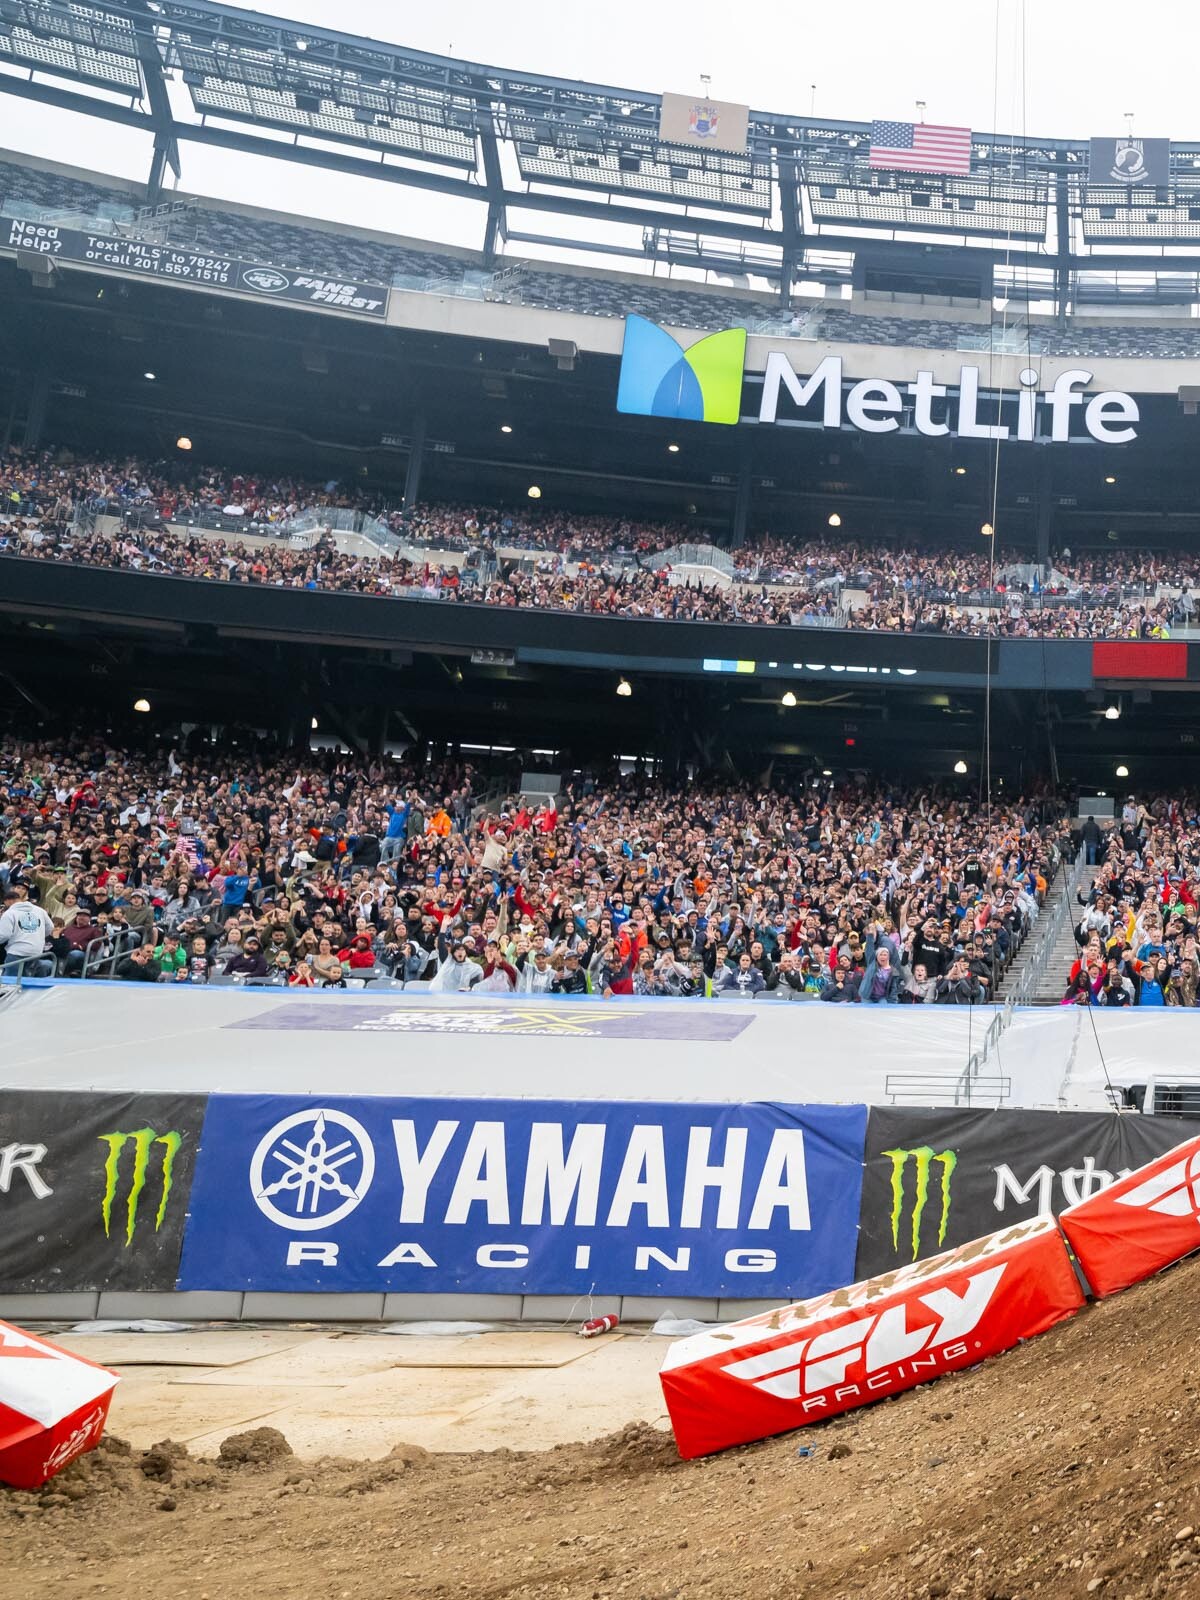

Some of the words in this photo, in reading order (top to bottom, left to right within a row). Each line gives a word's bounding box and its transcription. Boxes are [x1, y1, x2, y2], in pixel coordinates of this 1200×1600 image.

[8, 232, 62, 252] Help?
[11, 219, 59, 239] Need
[85, 249, 101, 259] or
[104, 252, 130, 266] call
[134, 257, 228, 283] 201.559.1515
[87, 237, 120, 251] Text
[171, 252, 185, 263] to
[189, 255, 231, 272] 78247
[293, 276, 357, 296] FANS
[311, 289, 383, 312] FIRST
[758, 351, 1140, 444] MetLife
[392, 1119, 811, 1230] YAMAHA
[286, 1241, 777, 1272] RACING
[720, 1262, 1008, 1399] FLY
[802, 1341, 967, 1413] RACING
